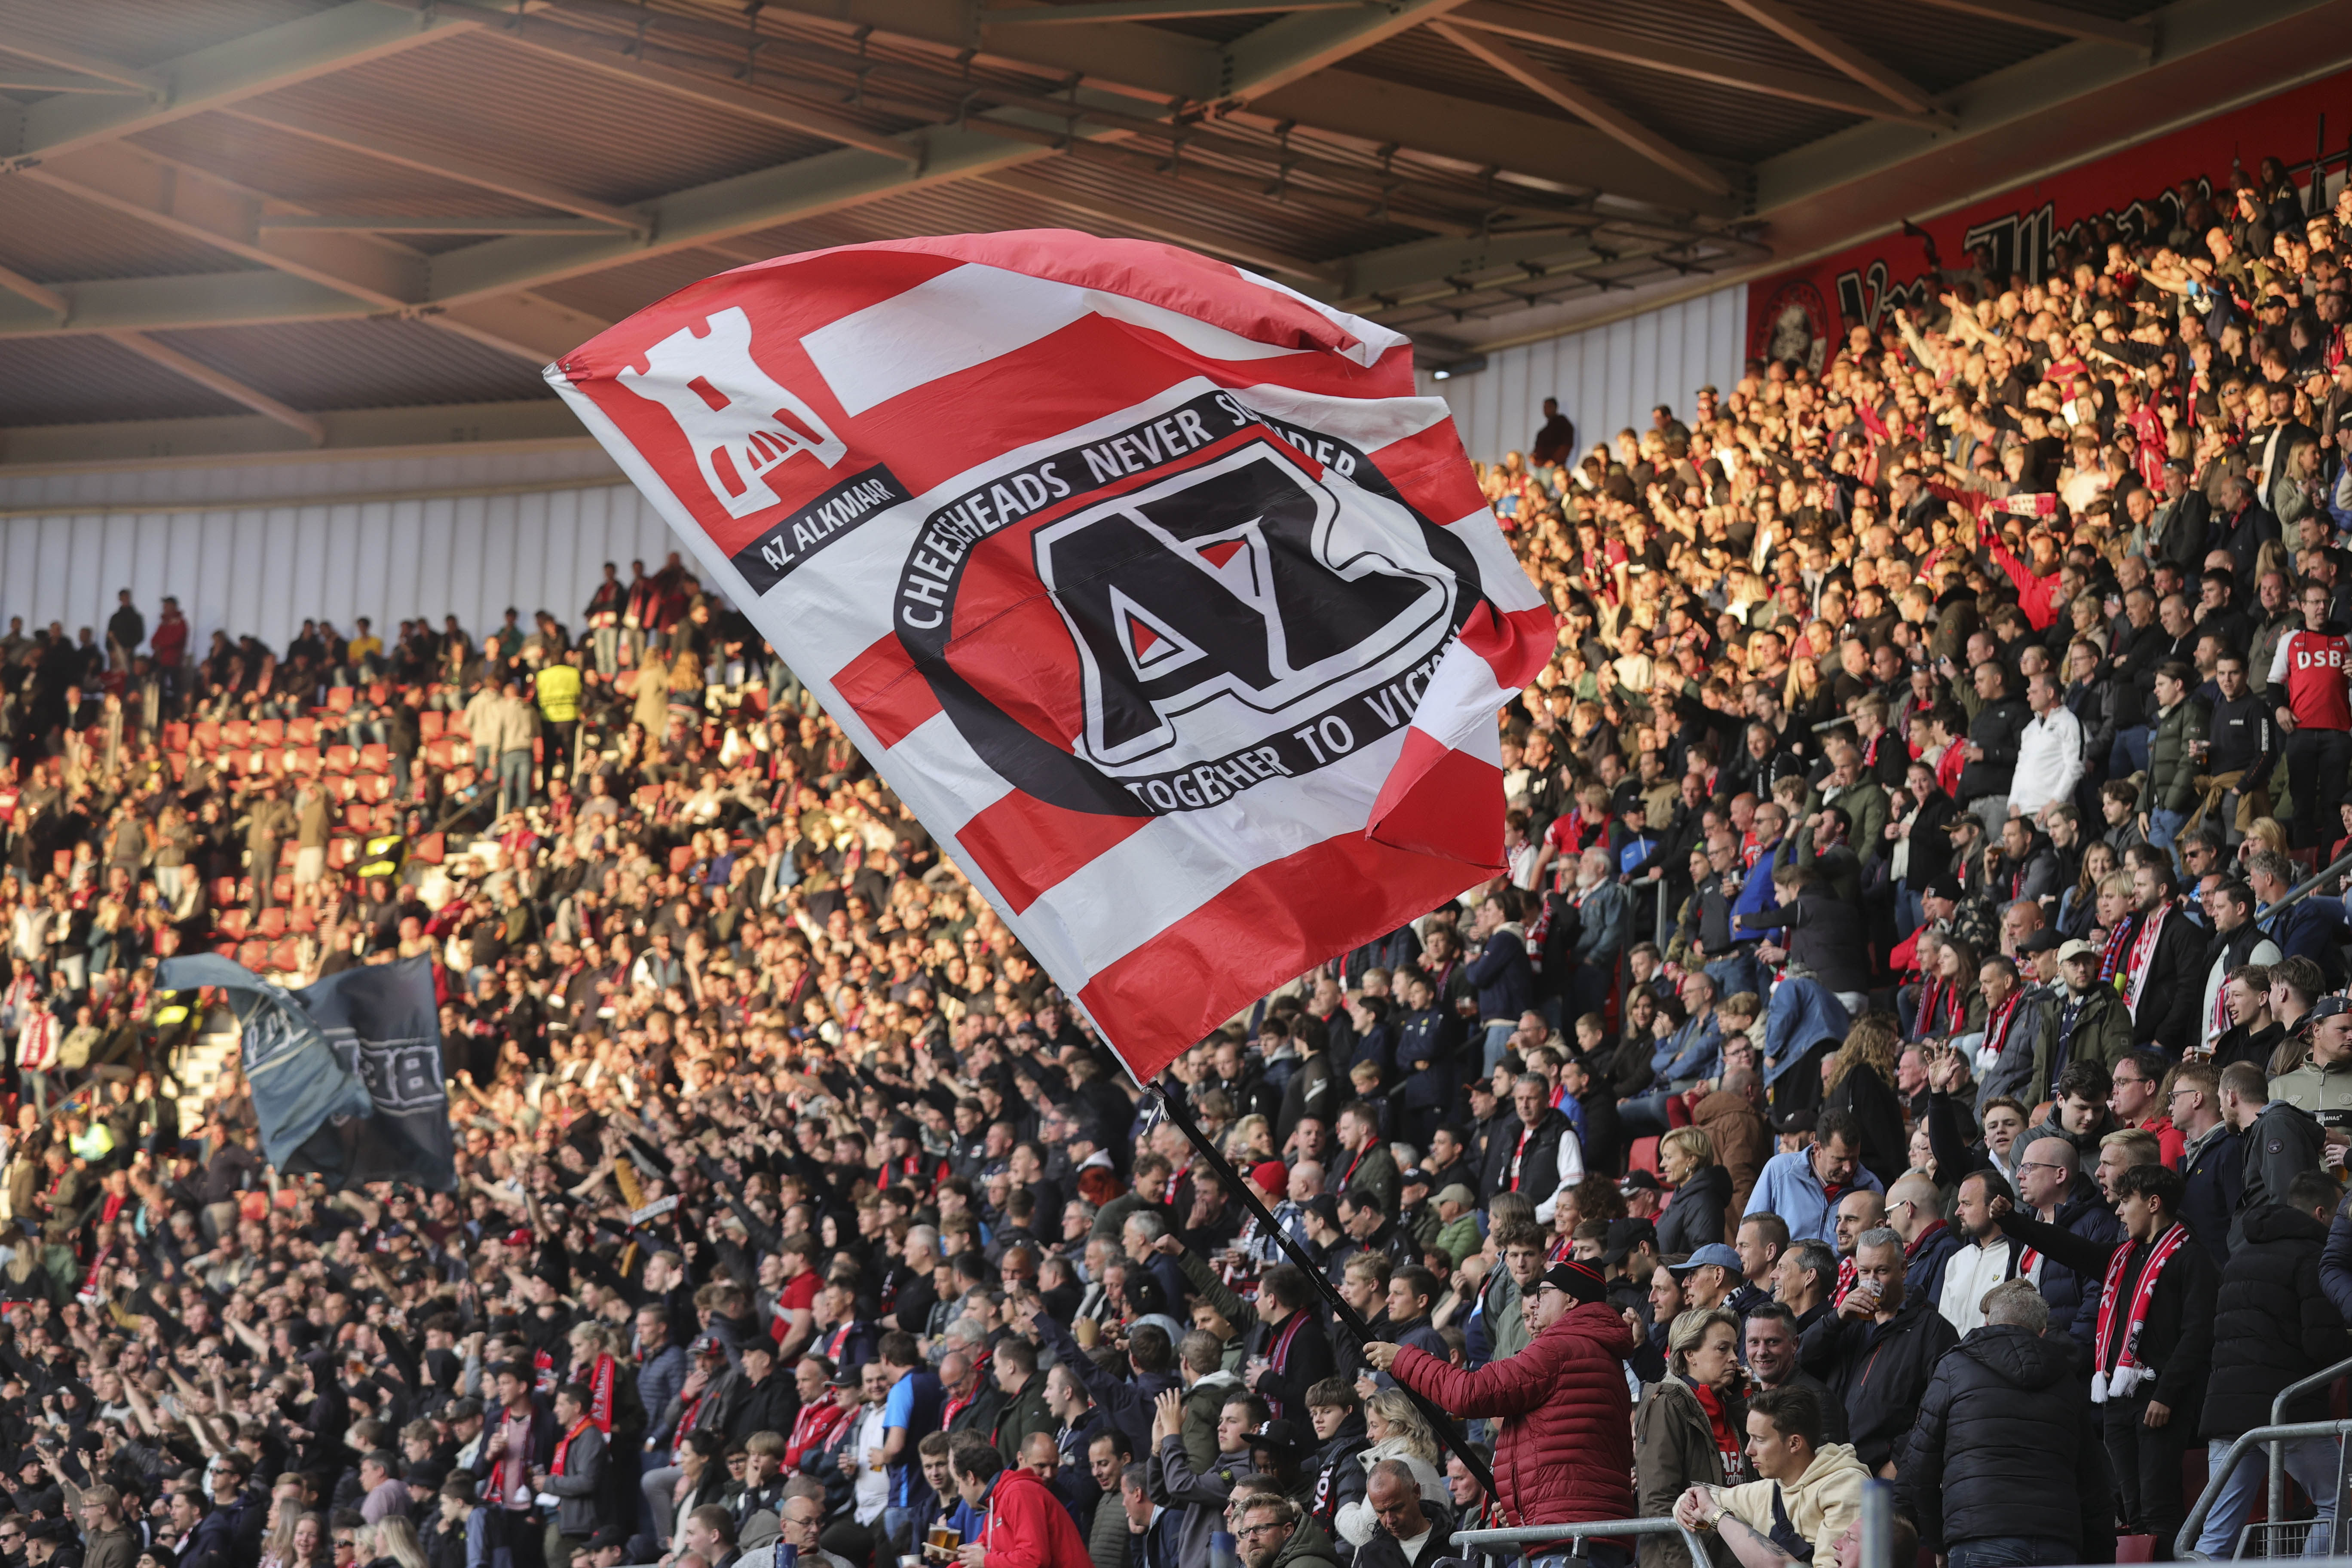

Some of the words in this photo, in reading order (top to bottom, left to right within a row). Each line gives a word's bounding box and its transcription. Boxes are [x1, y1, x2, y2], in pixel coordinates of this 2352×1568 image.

[761, 535, 795, 571] AZ
[792, 478, 896, 552] ALKMAAR
[903, 462, 1070, 629] CHEESEHEADS
[1081, 409, 1214, 483] NEVER
[1215, 394, 1357, 484] SUDER
[1038, 447, 1451, 759] AZ
[2297, 650, 2341, 670] DSB
[1293, 715, 1354, 764] TO
[1720, 1450, 1743, 1473] AFA
